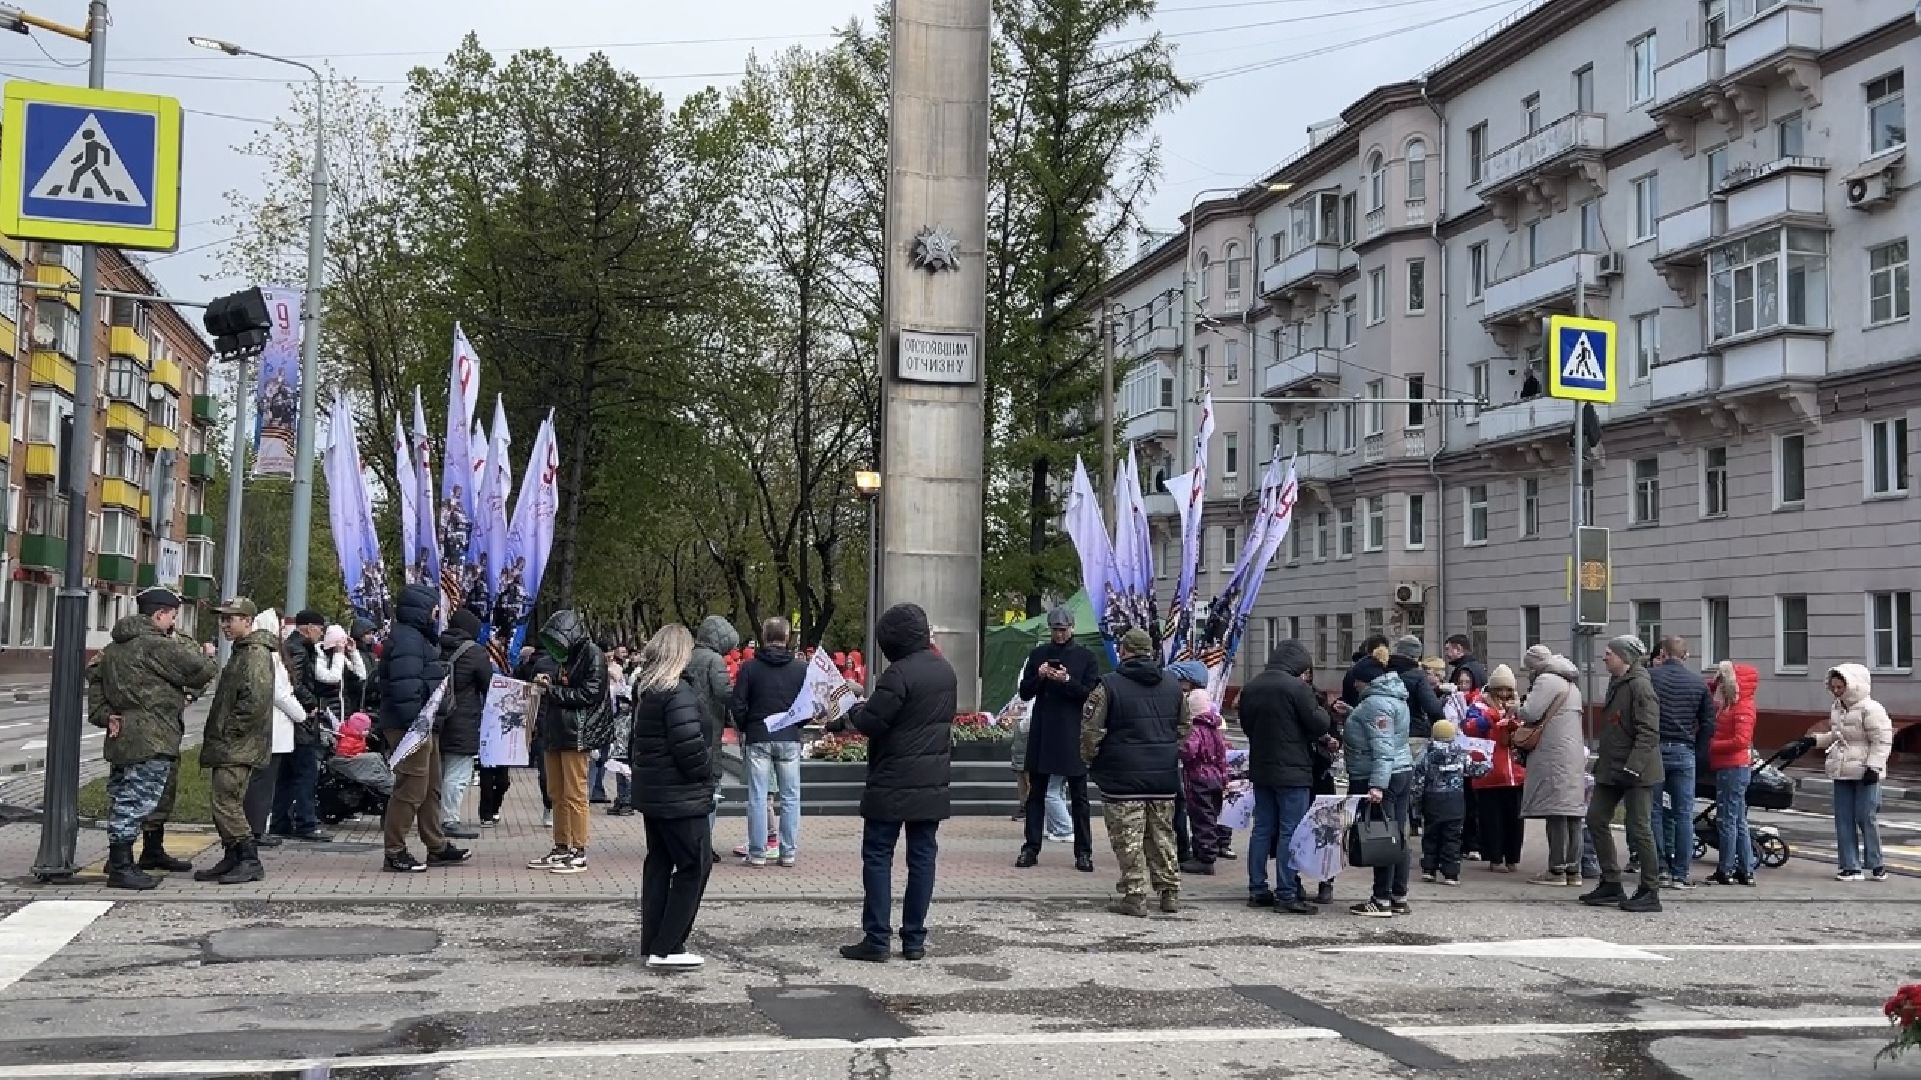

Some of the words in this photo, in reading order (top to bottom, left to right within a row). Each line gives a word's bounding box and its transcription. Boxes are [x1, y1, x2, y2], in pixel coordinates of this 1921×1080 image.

[276, 302, 289, 330] 9
[904, 338, 968, 357] ОТСТОЯВШИМ
[906, 356, 964, 374] ОТЧИЗНУ
